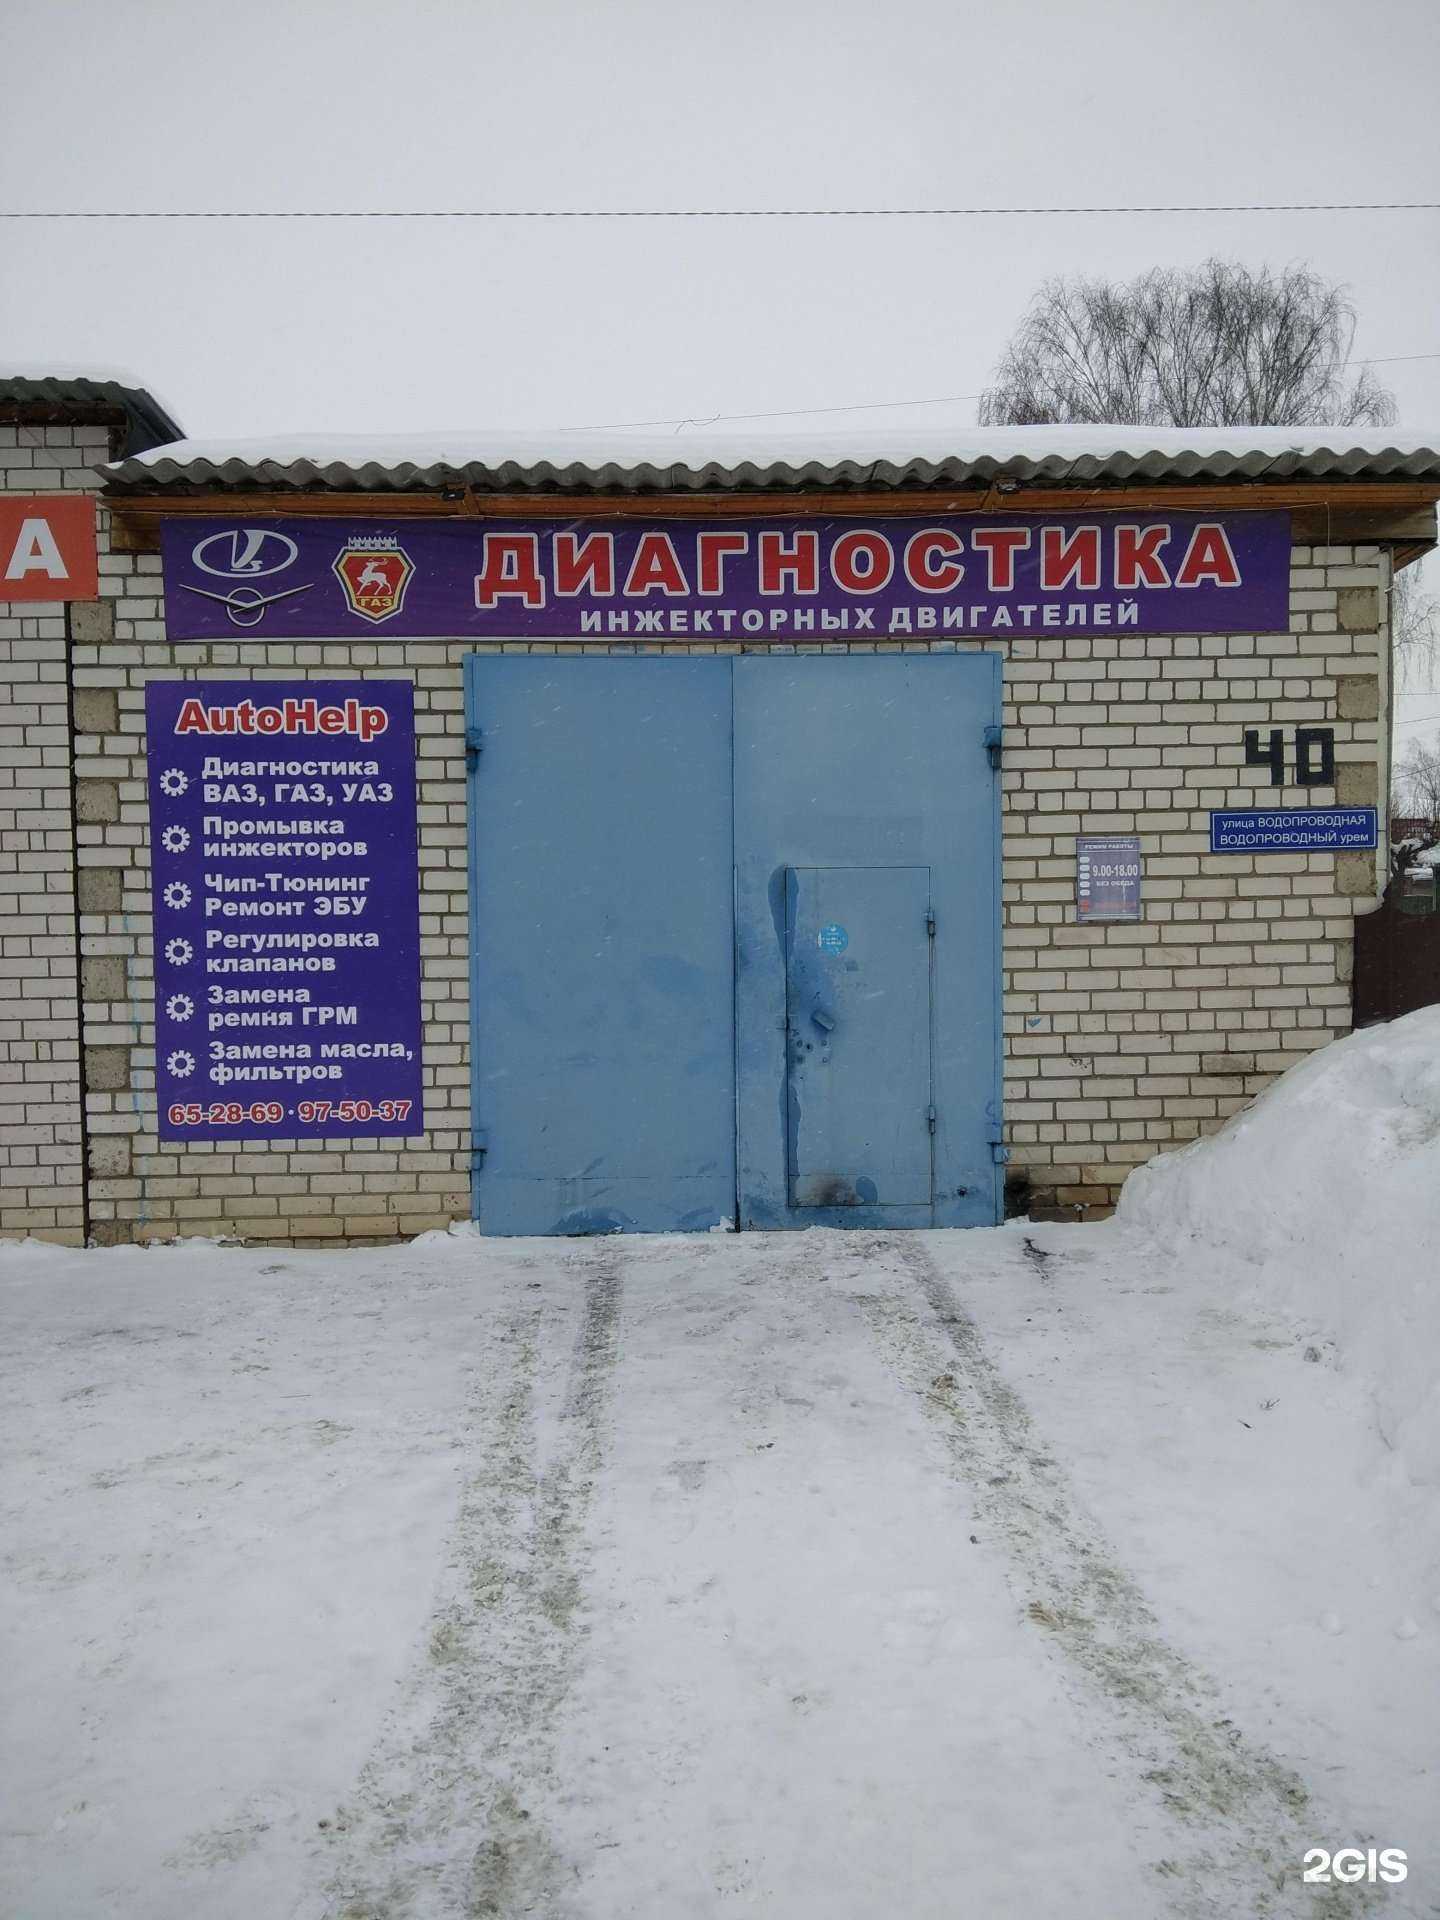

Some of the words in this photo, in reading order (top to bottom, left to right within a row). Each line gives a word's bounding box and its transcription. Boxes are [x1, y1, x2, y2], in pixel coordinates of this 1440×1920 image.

[474, 523, 1242, 609] ДИАГНОСТИКА
[358, 596, 393, 608] ГАЗ
[580, 606, 875, 632] ИНЖЕКТОРНЫХ
[888, 598, 1139, 633] ДВИГАТЕЛЕЙ
[175, 698, 387, 741] AutoHelp
[1245, 728, 1334, 785] 40
[202, 757, 379, 779] Диагностика
[203, 783, 265, 806] ВАЗ,
[275, 783, 333, 806] ГАЗ,
[343, 783, 393, 802] УАЗ
[203, 816, 345, 839] Промывка
[1222, 818, 1254, 829] улица
[1258, 815, 1366, 828] ВОДОПРОВОДНАЯ
[1220, 830, 1337, 846] ВОДОПРОВОДНЫЙ
[204, 841, 368, 860] инжекторов
[204, 873, 370, 892] Чип-Тюнинг
[205, 898, 305, 916] Ремонт
[313, 896, 367, 916] ЭБУ
[206, 929, 379, 952] Регулировка
[206, 956, 336, 973] клапанов
[208, 985, 310, 1004] Замена
[208, 1011, 293, 1031] ремня
[302, 1006, 357, 1025] ГРМ
[208, 1041, 311, 1060] Замена
[320, 1042, 413, 1060] масла,
[209, 1062, 343, 1085] фильтров
[168, 1102, 283, 1125] 65-28-69
[297, 1100, 412, 1121] 97-50-37
